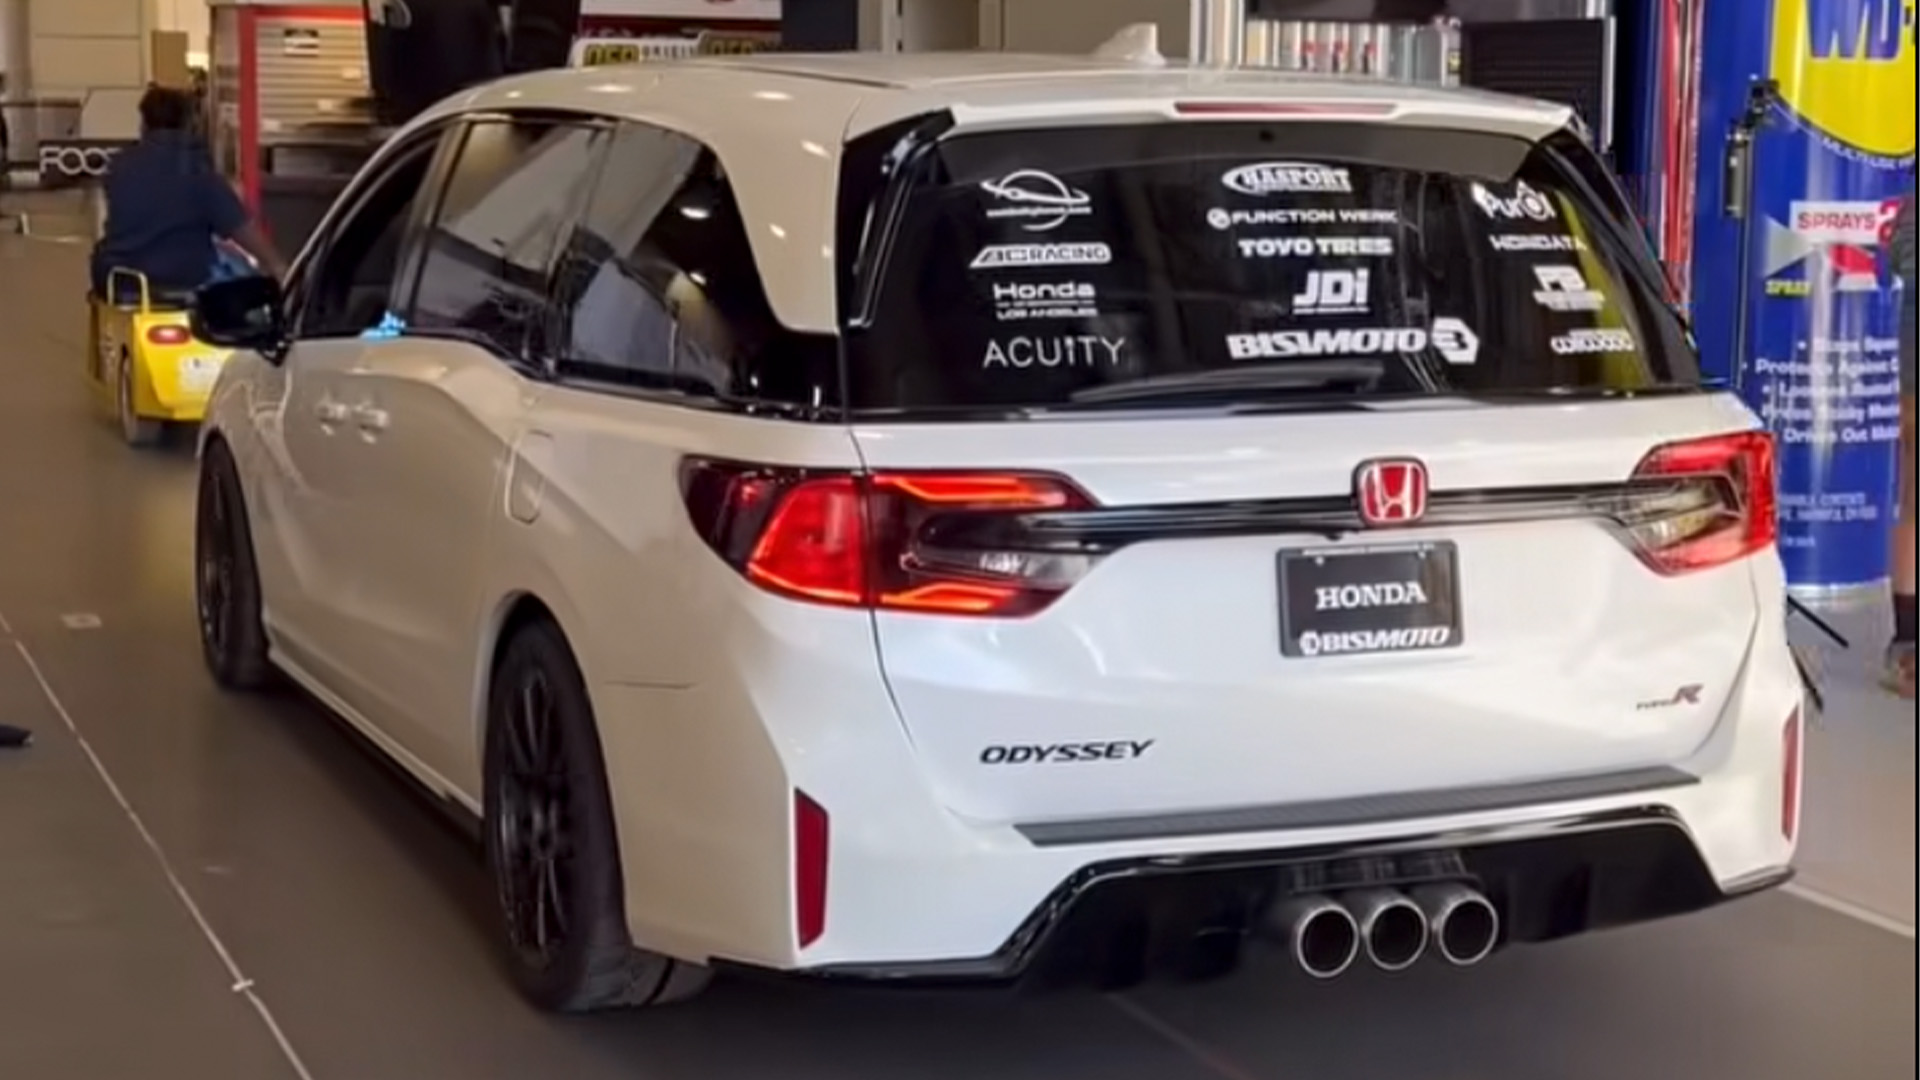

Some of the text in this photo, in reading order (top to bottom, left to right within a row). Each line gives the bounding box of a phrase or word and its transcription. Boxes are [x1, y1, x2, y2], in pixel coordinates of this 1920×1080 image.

[1241, 168, 1351, 187] HASPORT
[1231, 208, 1399, 225] FUNCTION WERK
[1798, 211, 1876, 230] SPRAYS
[1029, 247, 1107, 261] RACING
[1238, 236, 1393, 257] TOYO TIRES
[993, 280, 1096, 300] Honda
[1226, 328, 1428, 360] BISIMOTO
[1315, 582, 1428, 610] HONDA
[1323, 626, 1450, 652] BISIMOTO
[979, 738, 1156, 765] ODYSSEY
